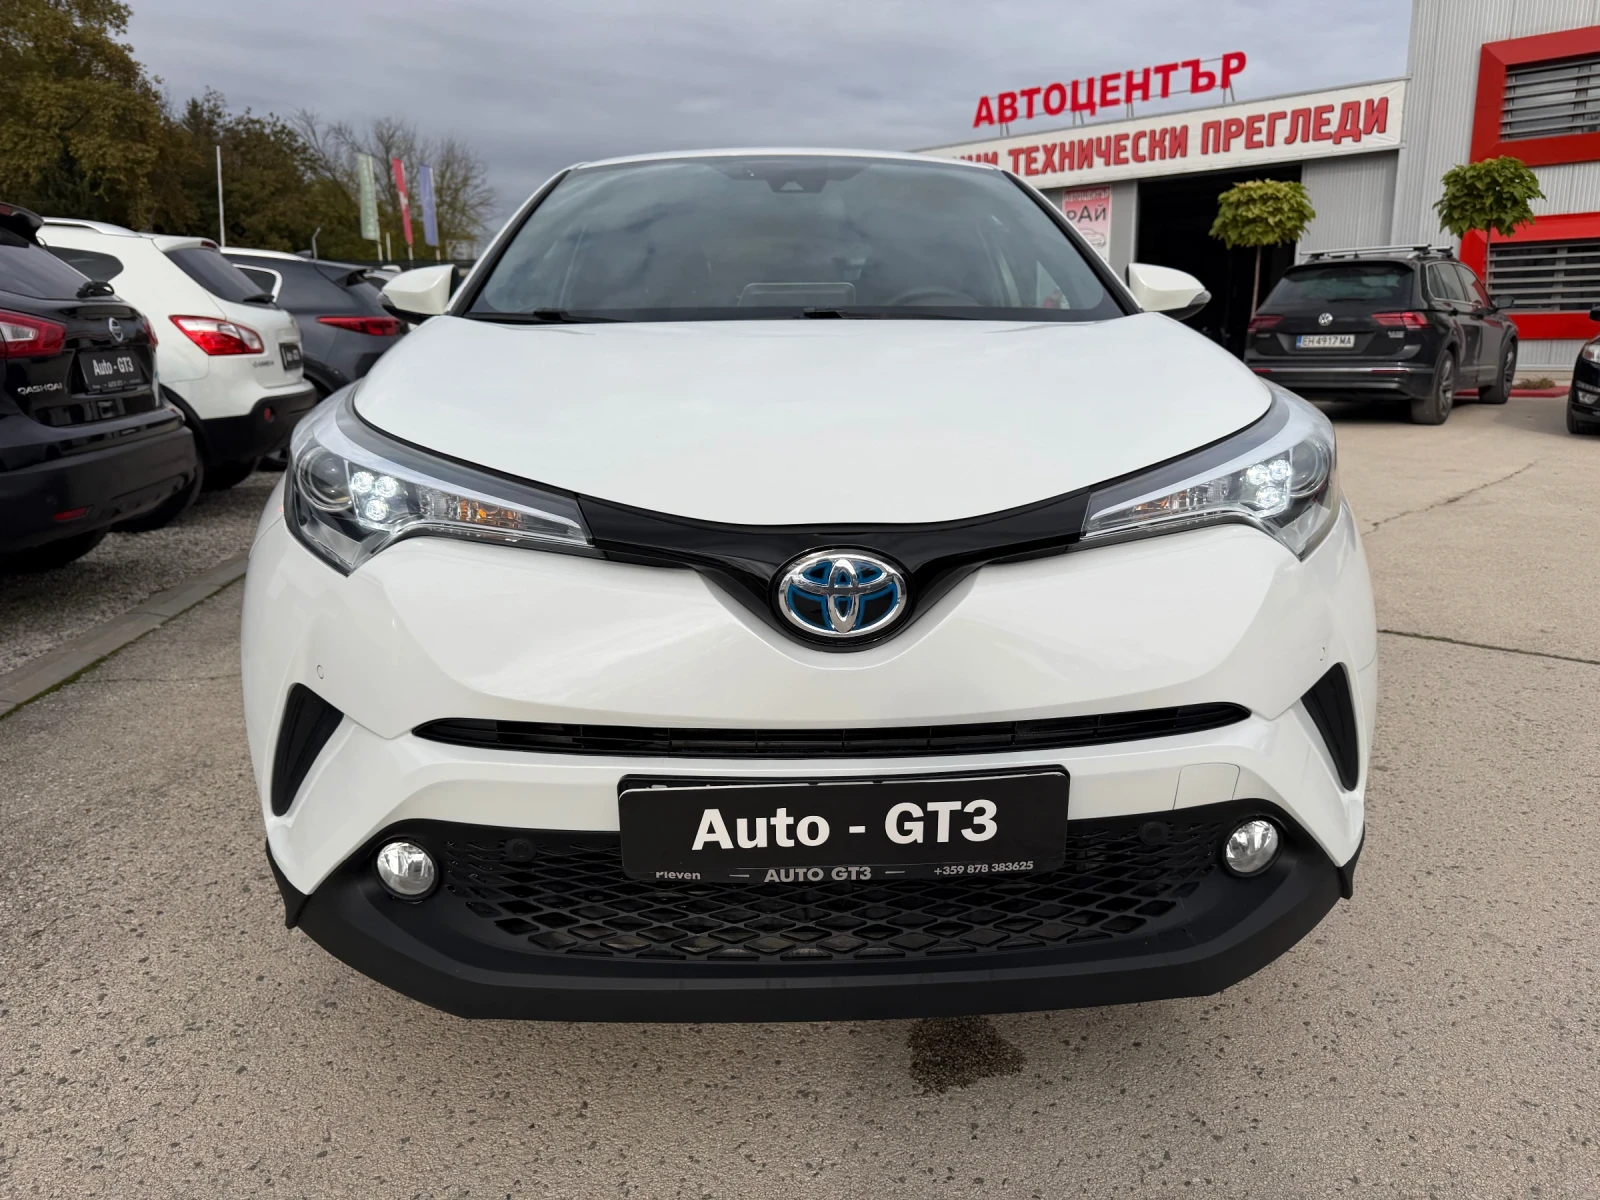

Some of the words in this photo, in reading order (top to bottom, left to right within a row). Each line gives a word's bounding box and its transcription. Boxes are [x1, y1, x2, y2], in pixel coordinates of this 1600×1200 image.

[972, 51, 1247, 128] АВТОЦЕНТЪР
[1008, 125, 1188, 176] ТЕХНИЧЕСКИ
[1201, 96, 1389, 155] ПРЕГЛЕДИ
[92, 359, 113, 376] Auto
[117, 356, 134, 373] GT3
[17, 382, 63, 396] QASHQAI
[691, 808, 830, 851] Auto
[884, 799, 998, 844] GT3
[764, 868, 824, 882] AUTO
[831, 867, 872, 881] GT3
[934, 865, 964, 876] +359
[967, 863, 989, 874] 878
[991, 861, 1034, 873] 383625
